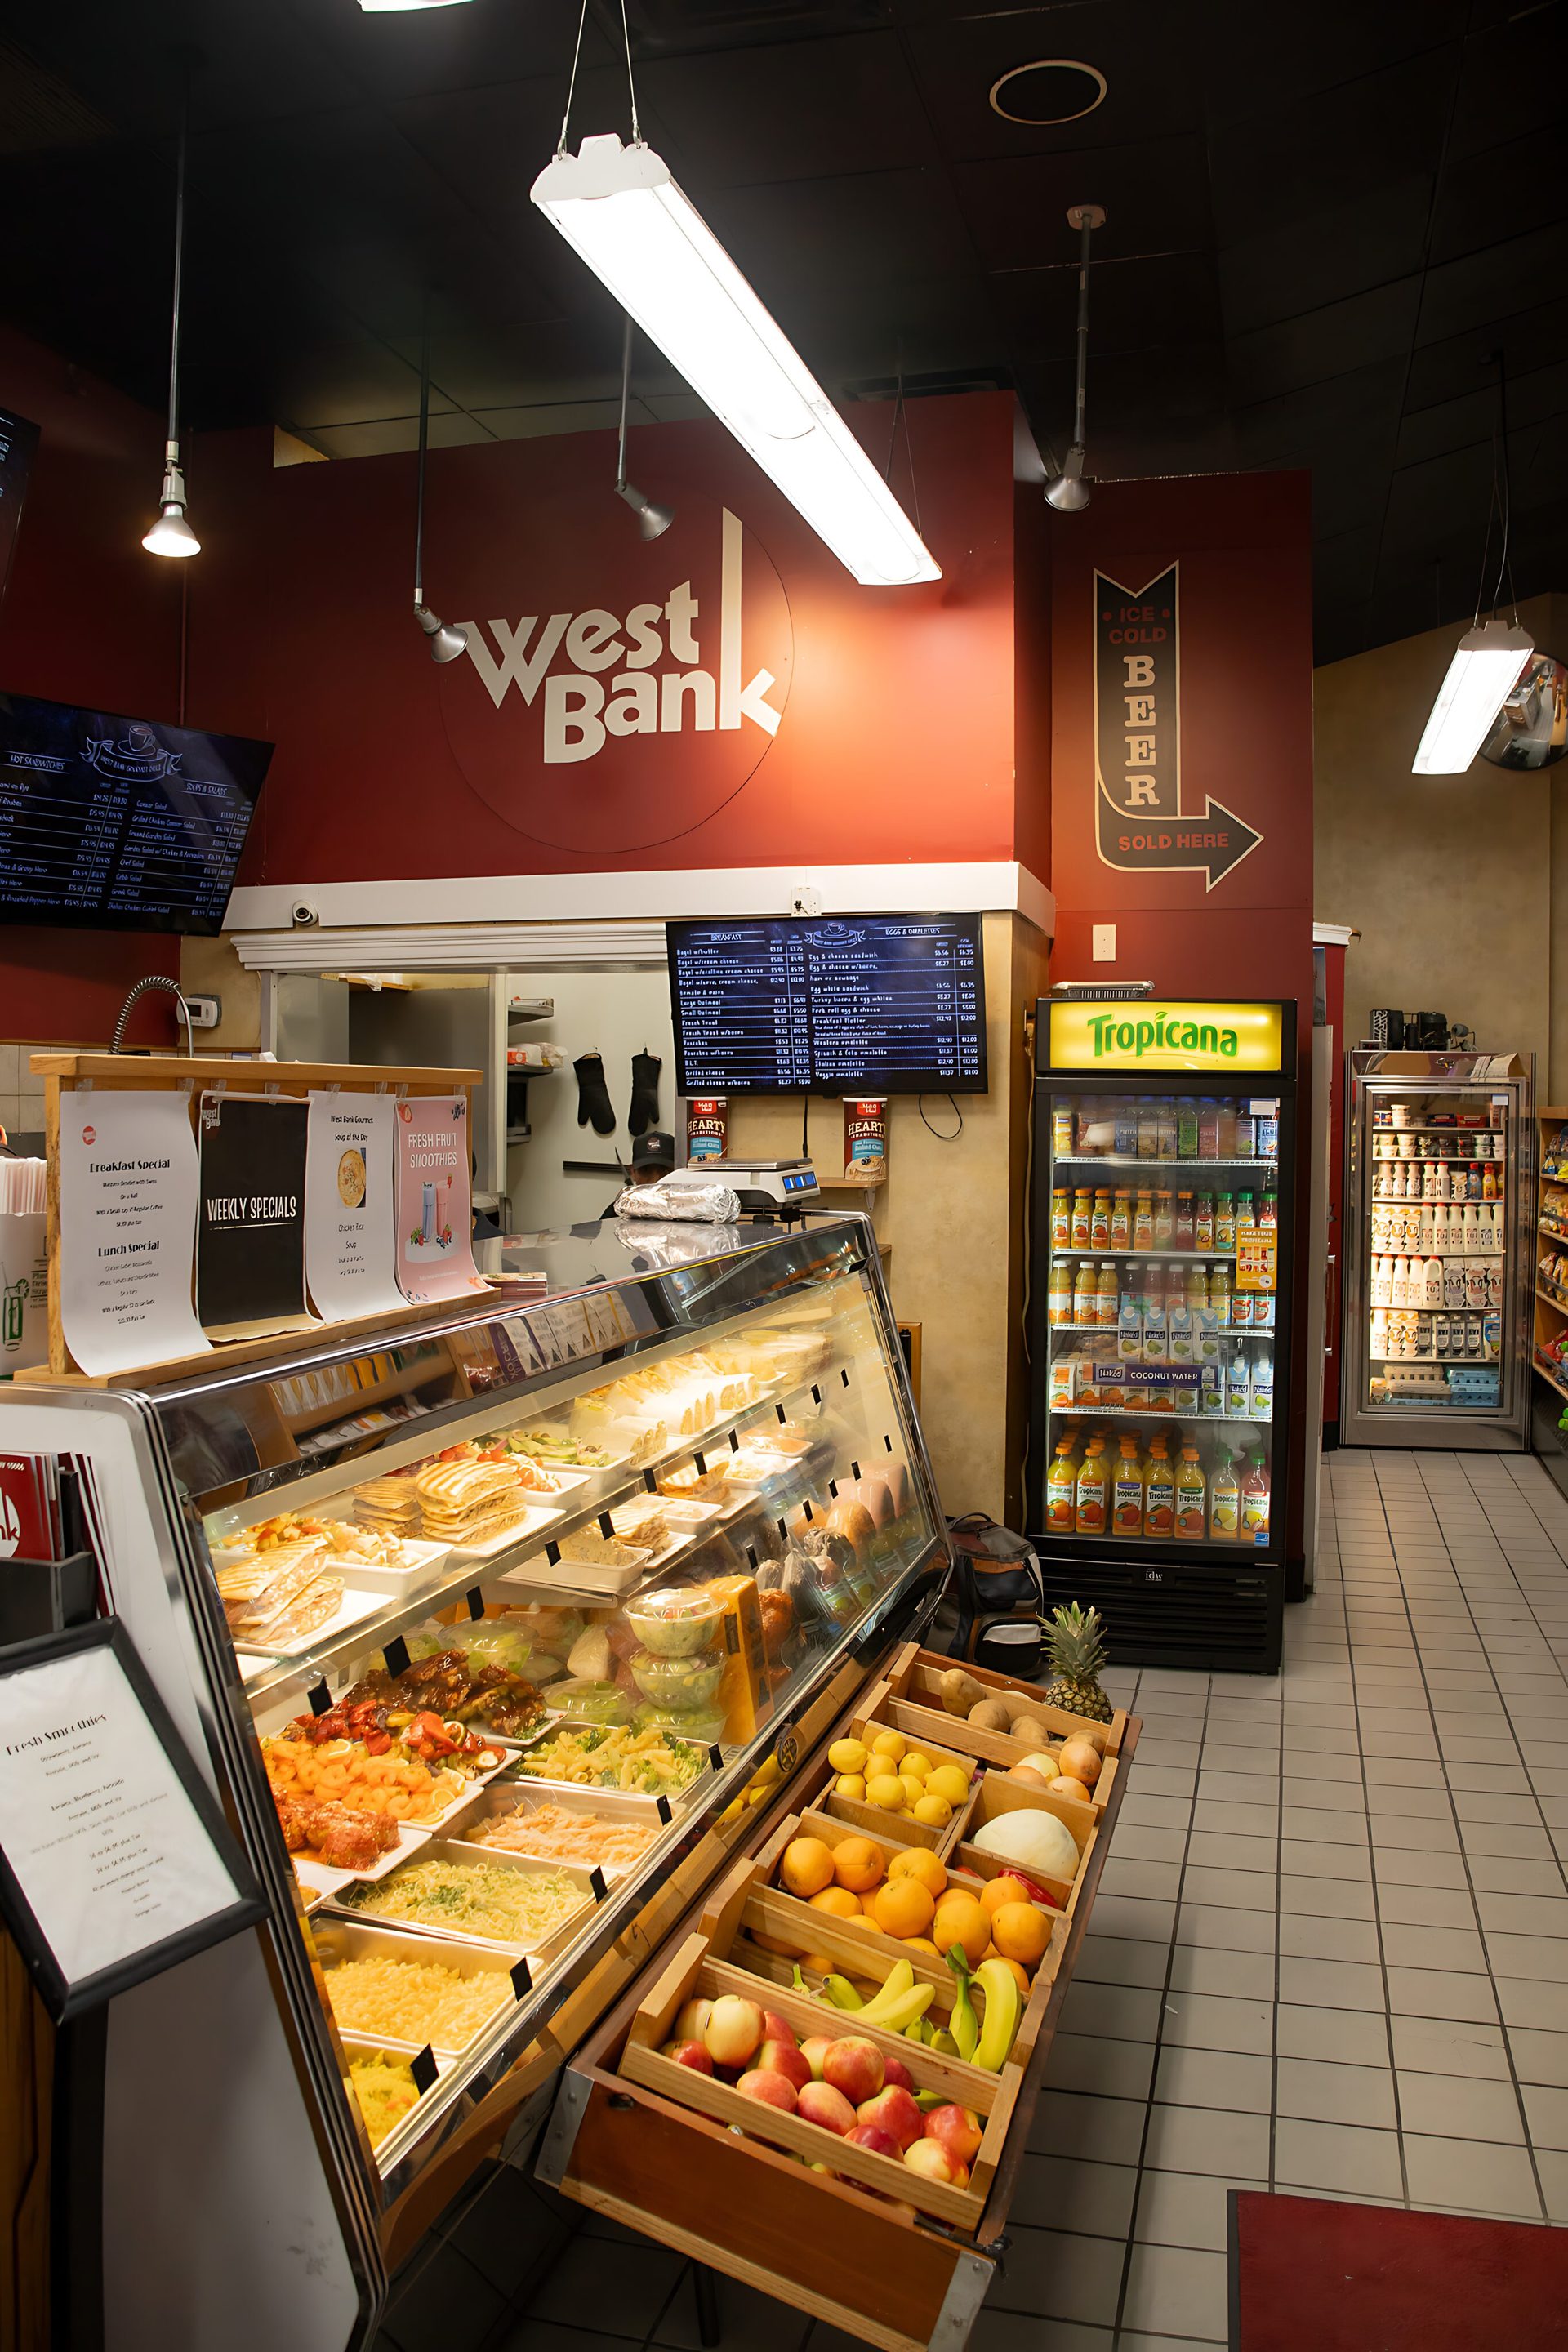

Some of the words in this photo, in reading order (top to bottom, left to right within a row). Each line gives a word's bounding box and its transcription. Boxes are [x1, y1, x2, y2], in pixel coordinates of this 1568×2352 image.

[1120, 606, 1155, 623] ICE
[544, 506, 782, 764] Bank
[1109, 627, 1167, 644] COLD
[1123, 654, 1160, 806] BEER
[10, 755, 24, 764] HOT
[24, 757, 65, 770] SANDWICHES
[154, 802, 167, 810] Salad
[163, 833, 176, 841] Salad
[1118, 834, 1172, 852] SOLD
[1177, 832, 1229, 848] HERE
[808, 953, 819, 961] Egg
[811, 986, 821, 994] Egg
[1087, 1011, 1239, 1058] Tropicana
[815, 1071, 834, 1080] Veggie
[206, 1102, 221, 1129] Bank
[331, 1115, 342, 1123] West
[343, 1115, 354, 1123] Bank
[354, 1116, 373, 1124] Gourmet
[688, 1120, 725, 1134] HEARTY
[335, 1134, 346, 1142] Soup
[347, 1133, 352, 1141] of
[408, 1134, 434, 1147] FRESH
[435, 1133, 457, 1147] FRUIT
[90, 1161, 135, 1173] Breakfast
[137, 1159, 170, 1169] Special
[410, 1152, 457, 1169] SMOOTHIES
[207, 1197, 247, 1221] WEEKLY
[250, 1196, 296, 1218] SPECIALS
[98, 1245, 127, 1257] Lunch
[128, 1240, 160, 1253] Special
[1099, 1369, 1123, 1378] Naked
[1079, 1486, 1102, 1495] Tropicana
[1117, 1490, 1142, 1498] Tropicana
[1149, 1491, 1173, 1500] Tropicana
[1179, 1494, 1204, 1503] Tropicana
[1214, 1494, 1238, 1503] Tropicana
[1243, 1497, 1267, 1506] Tropicana
[1145, 1571, 1163, 1579] idw
[6, 1736, 43, 1756] Fresh
[44, 1714, 107, 1740] Smoothies
